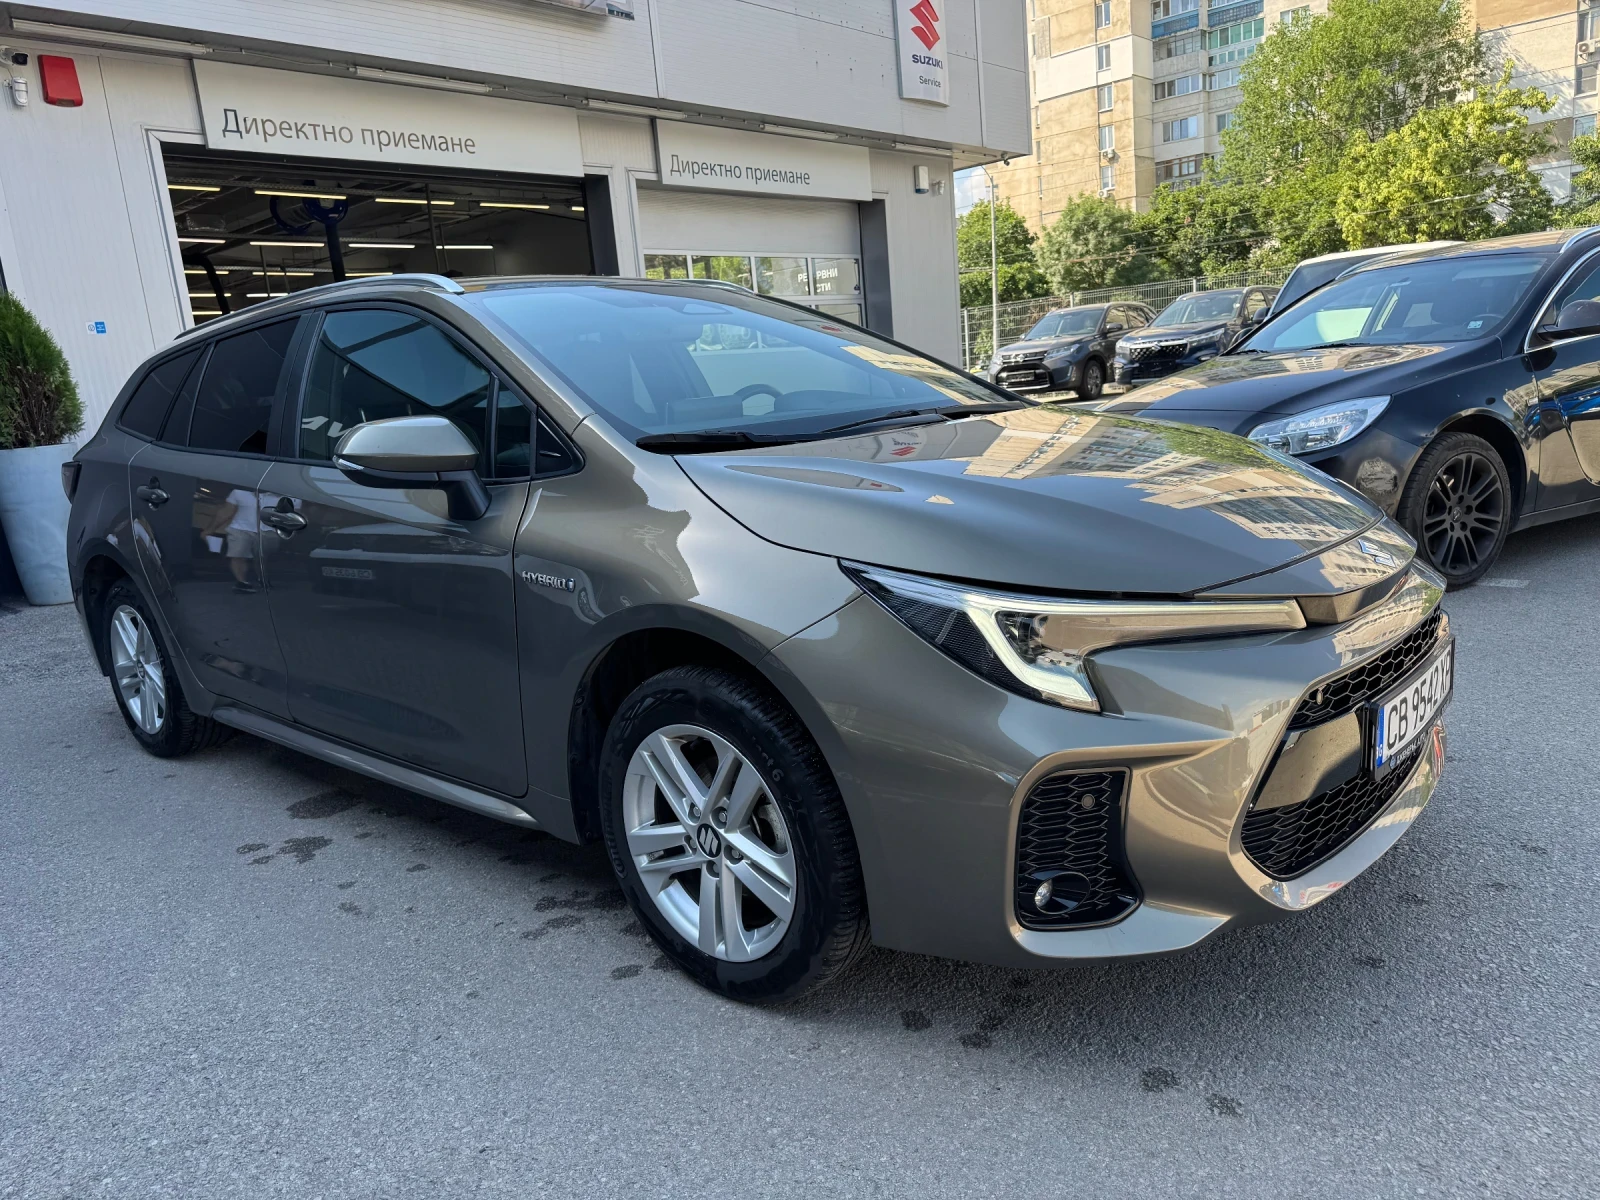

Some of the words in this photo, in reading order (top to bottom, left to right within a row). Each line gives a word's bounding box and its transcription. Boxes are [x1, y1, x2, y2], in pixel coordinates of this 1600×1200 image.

[912, 54, 943, 70] SUZUKI
[919, 75, 942, 88] Service
[222, 108, 354, 144] Директно
[361, 128, 476, 154] приемане
[670, 154, 742, 179] Директно
[745, 166, 810, 185] приемане
[798, 268, 838, 282] РЕРВНИ
[522, 571, 567, 590] HYBRID
[1387, 696, 1408, 751] CB
[1412, 665, 1439, 731] 9542
